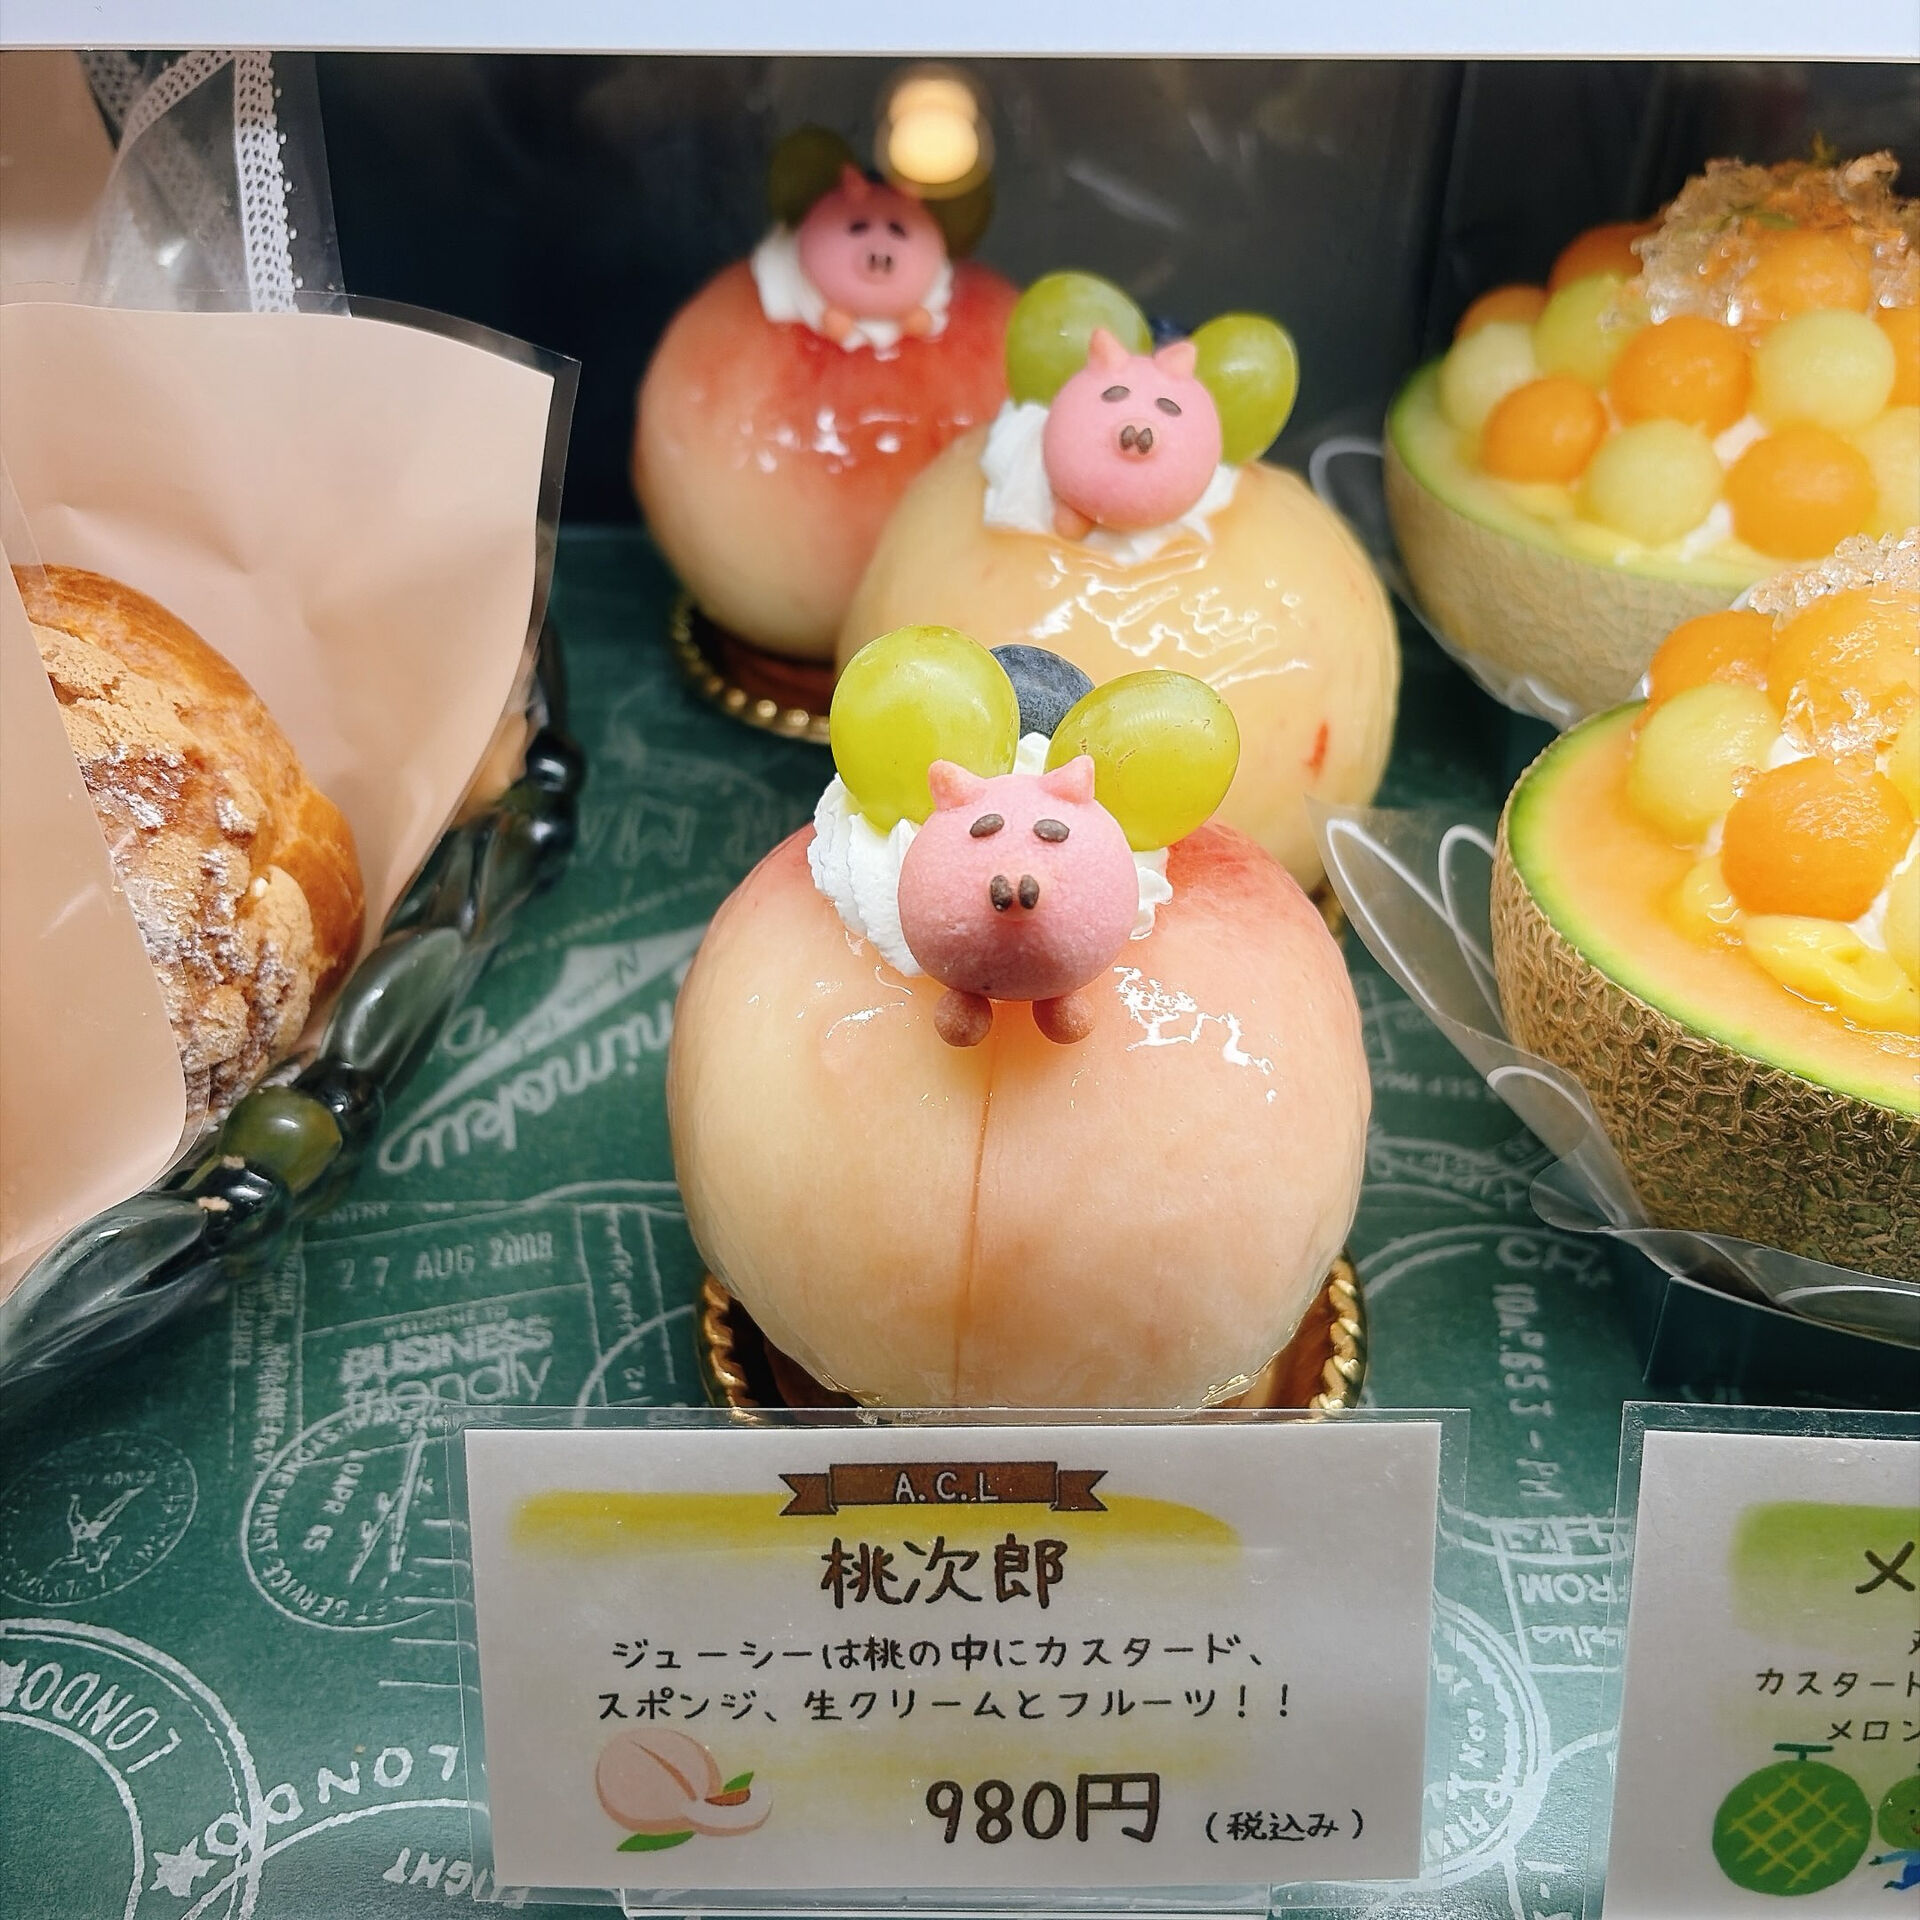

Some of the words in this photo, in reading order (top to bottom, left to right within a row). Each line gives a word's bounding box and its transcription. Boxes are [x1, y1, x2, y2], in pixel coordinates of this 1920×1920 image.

[413, 1244, 475, 1281] AUG
[338, 1314, 555, 1386] BUSINESS
[820, 1532, 1070, 1610] 桃次郎
[610, 1632, 1266, 1672] ジューシーは桃の中にカスタード、
[924, 1771, 1161, 1844] 980円
